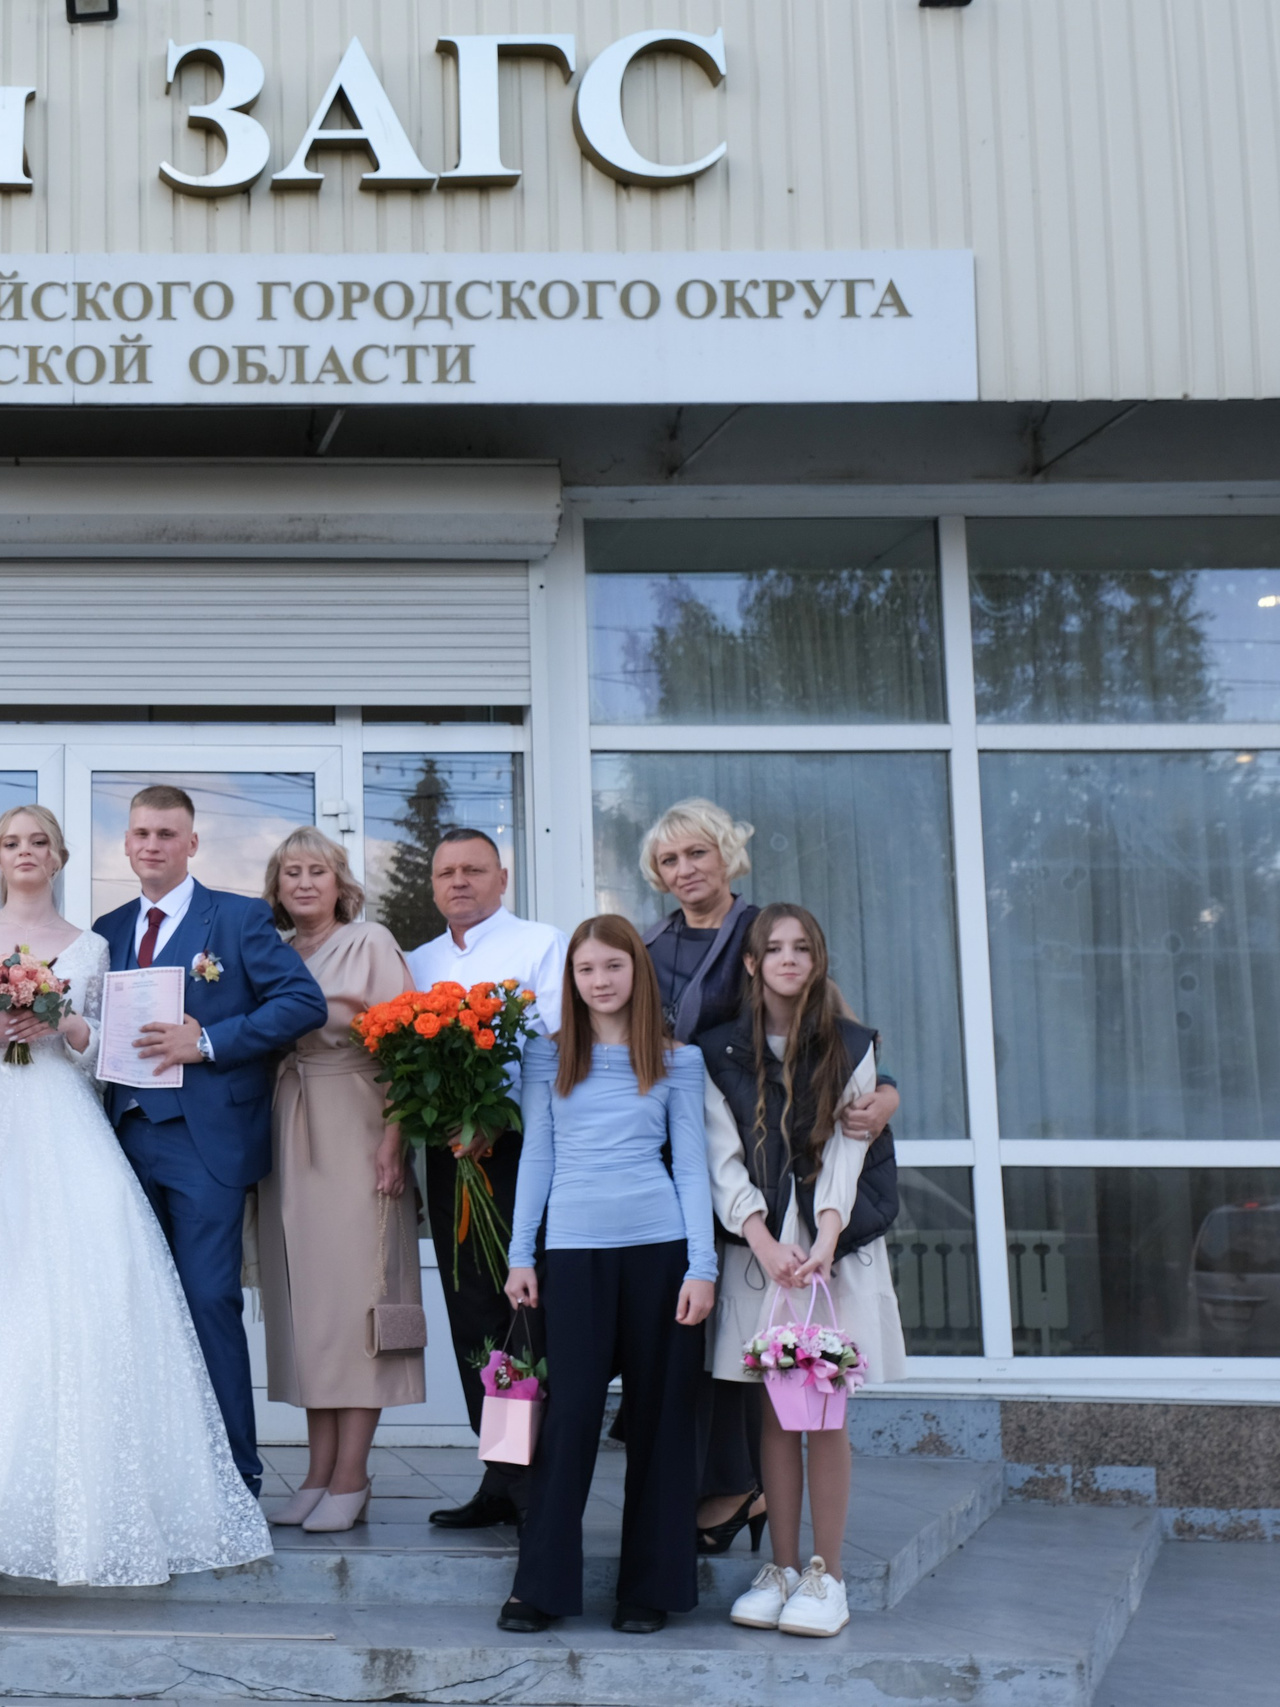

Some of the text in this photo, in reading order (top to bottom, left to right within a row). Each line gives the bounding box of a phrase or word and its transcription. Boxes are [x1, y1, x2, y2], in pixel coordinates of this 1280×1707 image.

[159, 28, 727, 197] ЗАГС
[256, 279, 661, 330] ГОРОДСКОГО
[676, 277, 913, 320] ОКРУГА
[189, 343, 476, 386] ОБЛАСТИ
